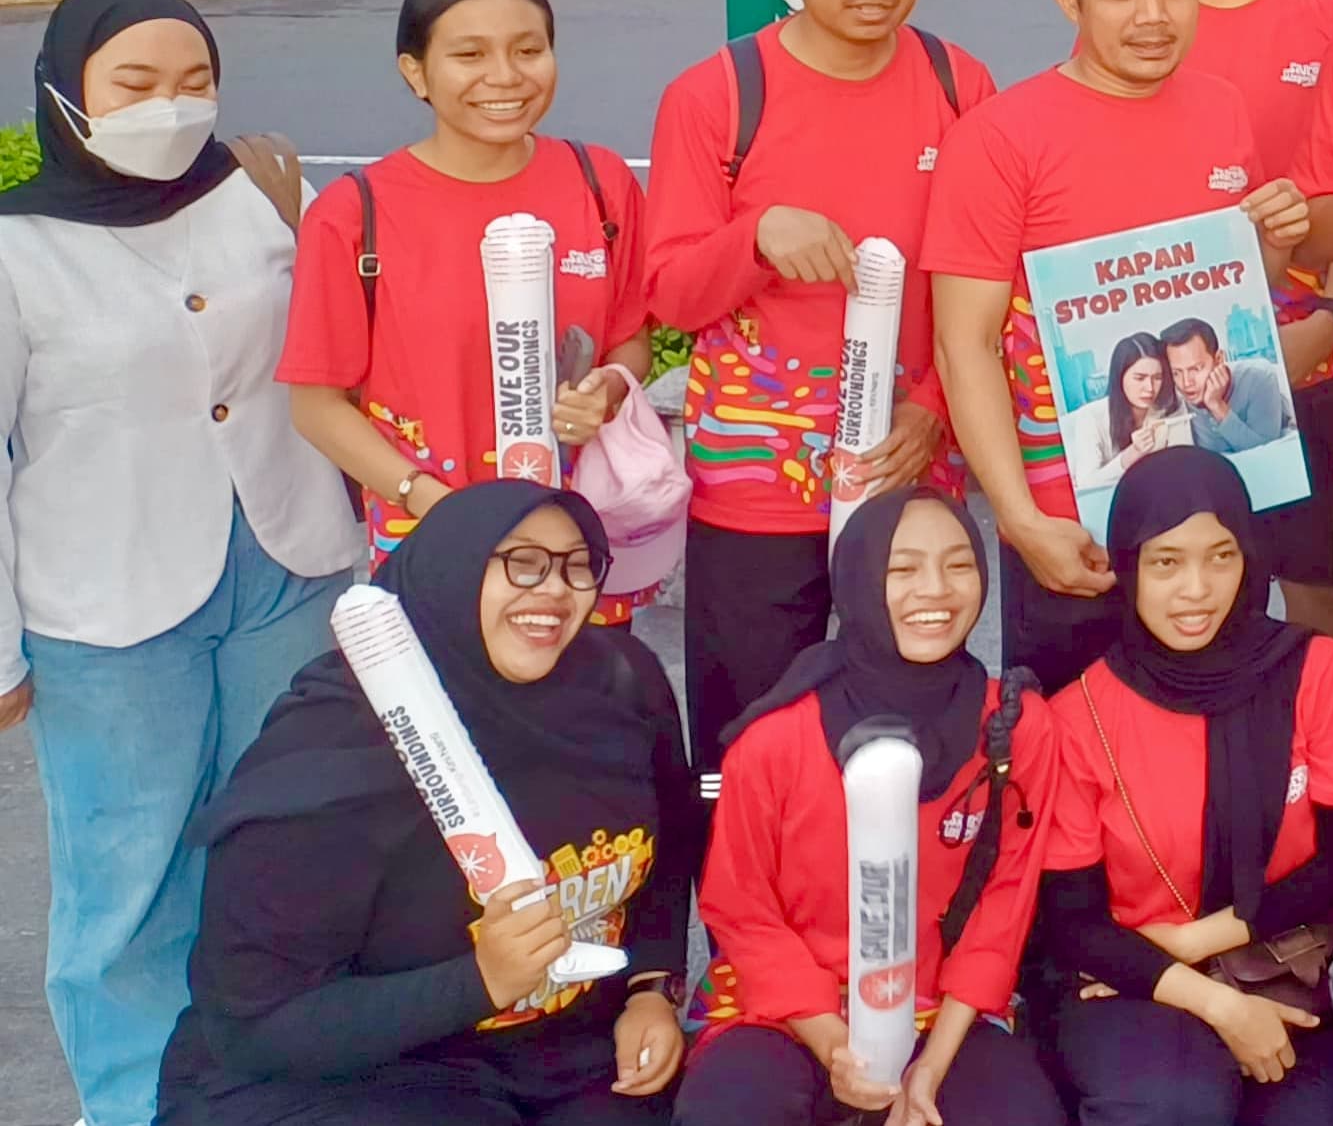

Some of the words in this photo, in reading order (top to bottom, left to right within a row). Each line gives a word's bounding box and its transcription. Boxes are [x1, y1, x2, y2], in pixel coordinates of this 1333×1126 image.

[1055, 288, 1127, 325] STOP
[1134, 261, 1245, 307] ROKOK?
[1095, 242, 1195, 286] KAPAN
[496, 321, 521, 372] OUR
[522, 319, 543, 436] SURROUNDINGS
[500, 375, 523, 437] SAVE
[387, 705, 466, 829] SURROUNDINGS
[545, 854, 632, 923] REN
